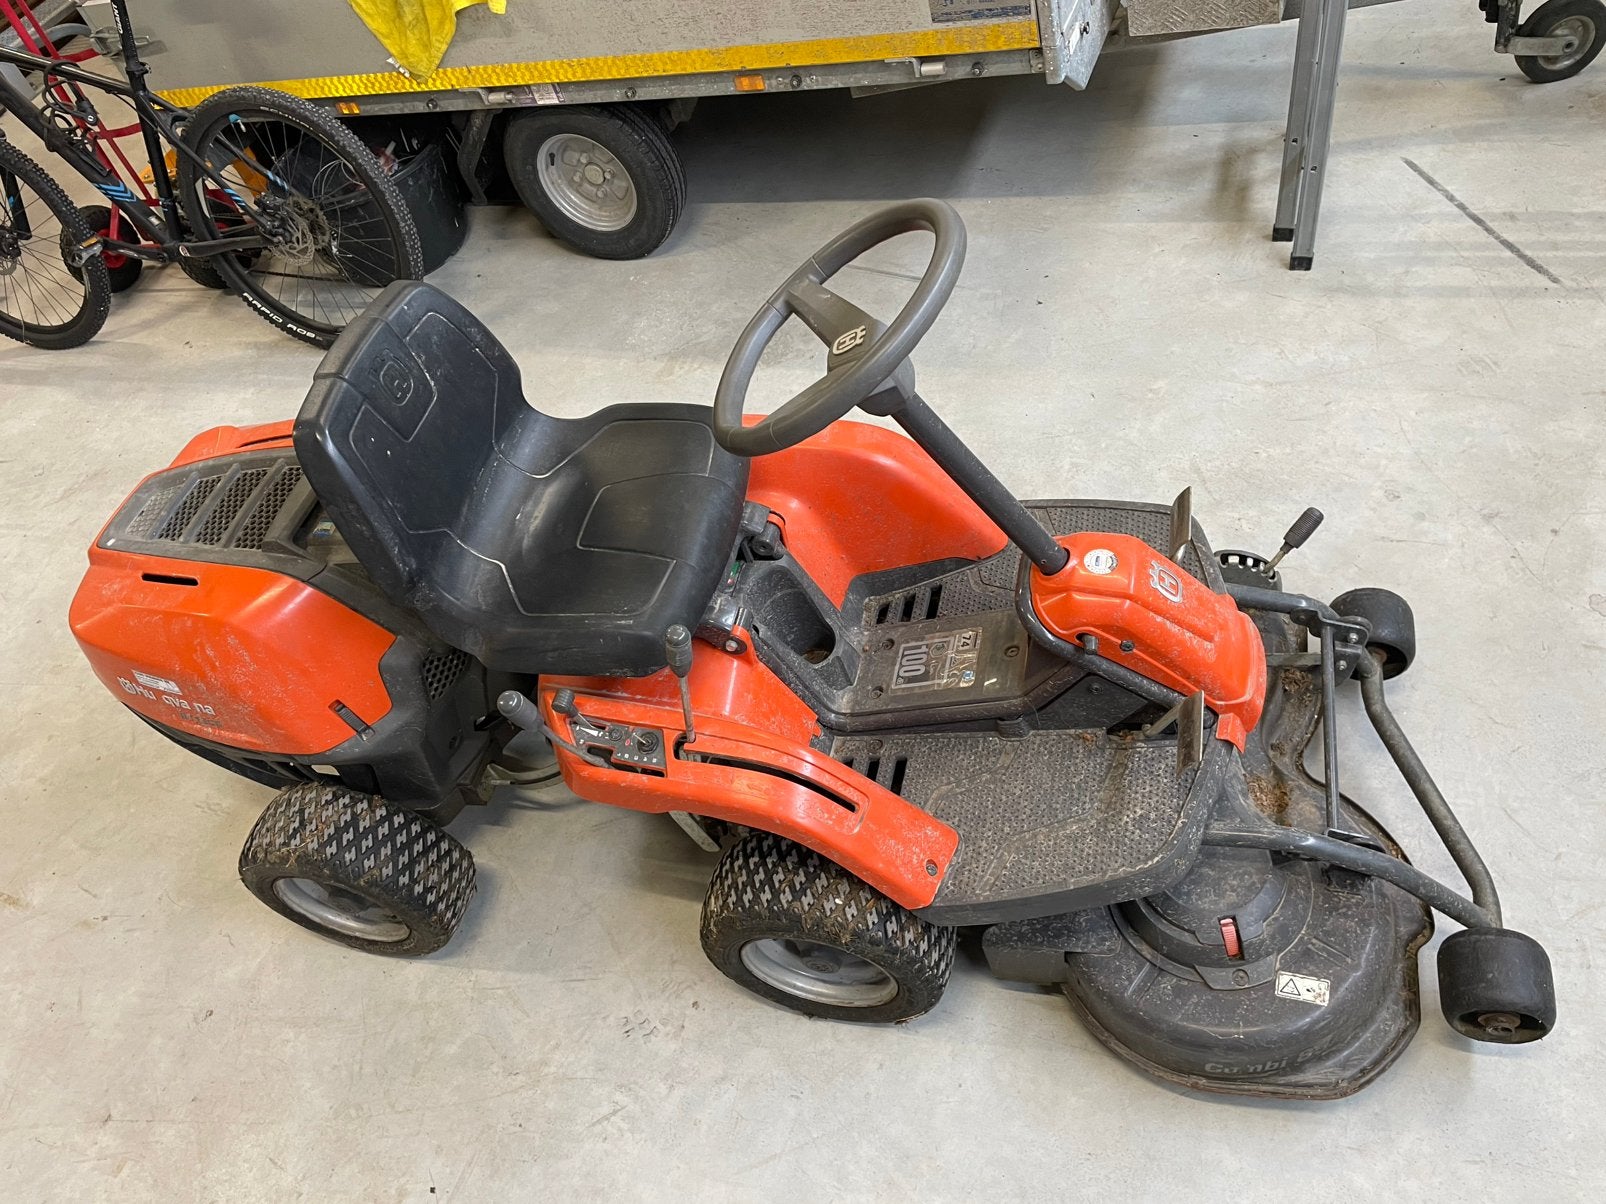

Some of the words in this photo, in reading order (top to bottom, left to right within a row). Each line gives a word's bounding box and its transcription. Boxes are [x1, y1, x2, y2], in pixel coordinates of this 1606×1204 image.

[242, 292, 283, 323] RAPID
[286, 323, 317, 338] ROB
[898, 645, 929, 677] 100
